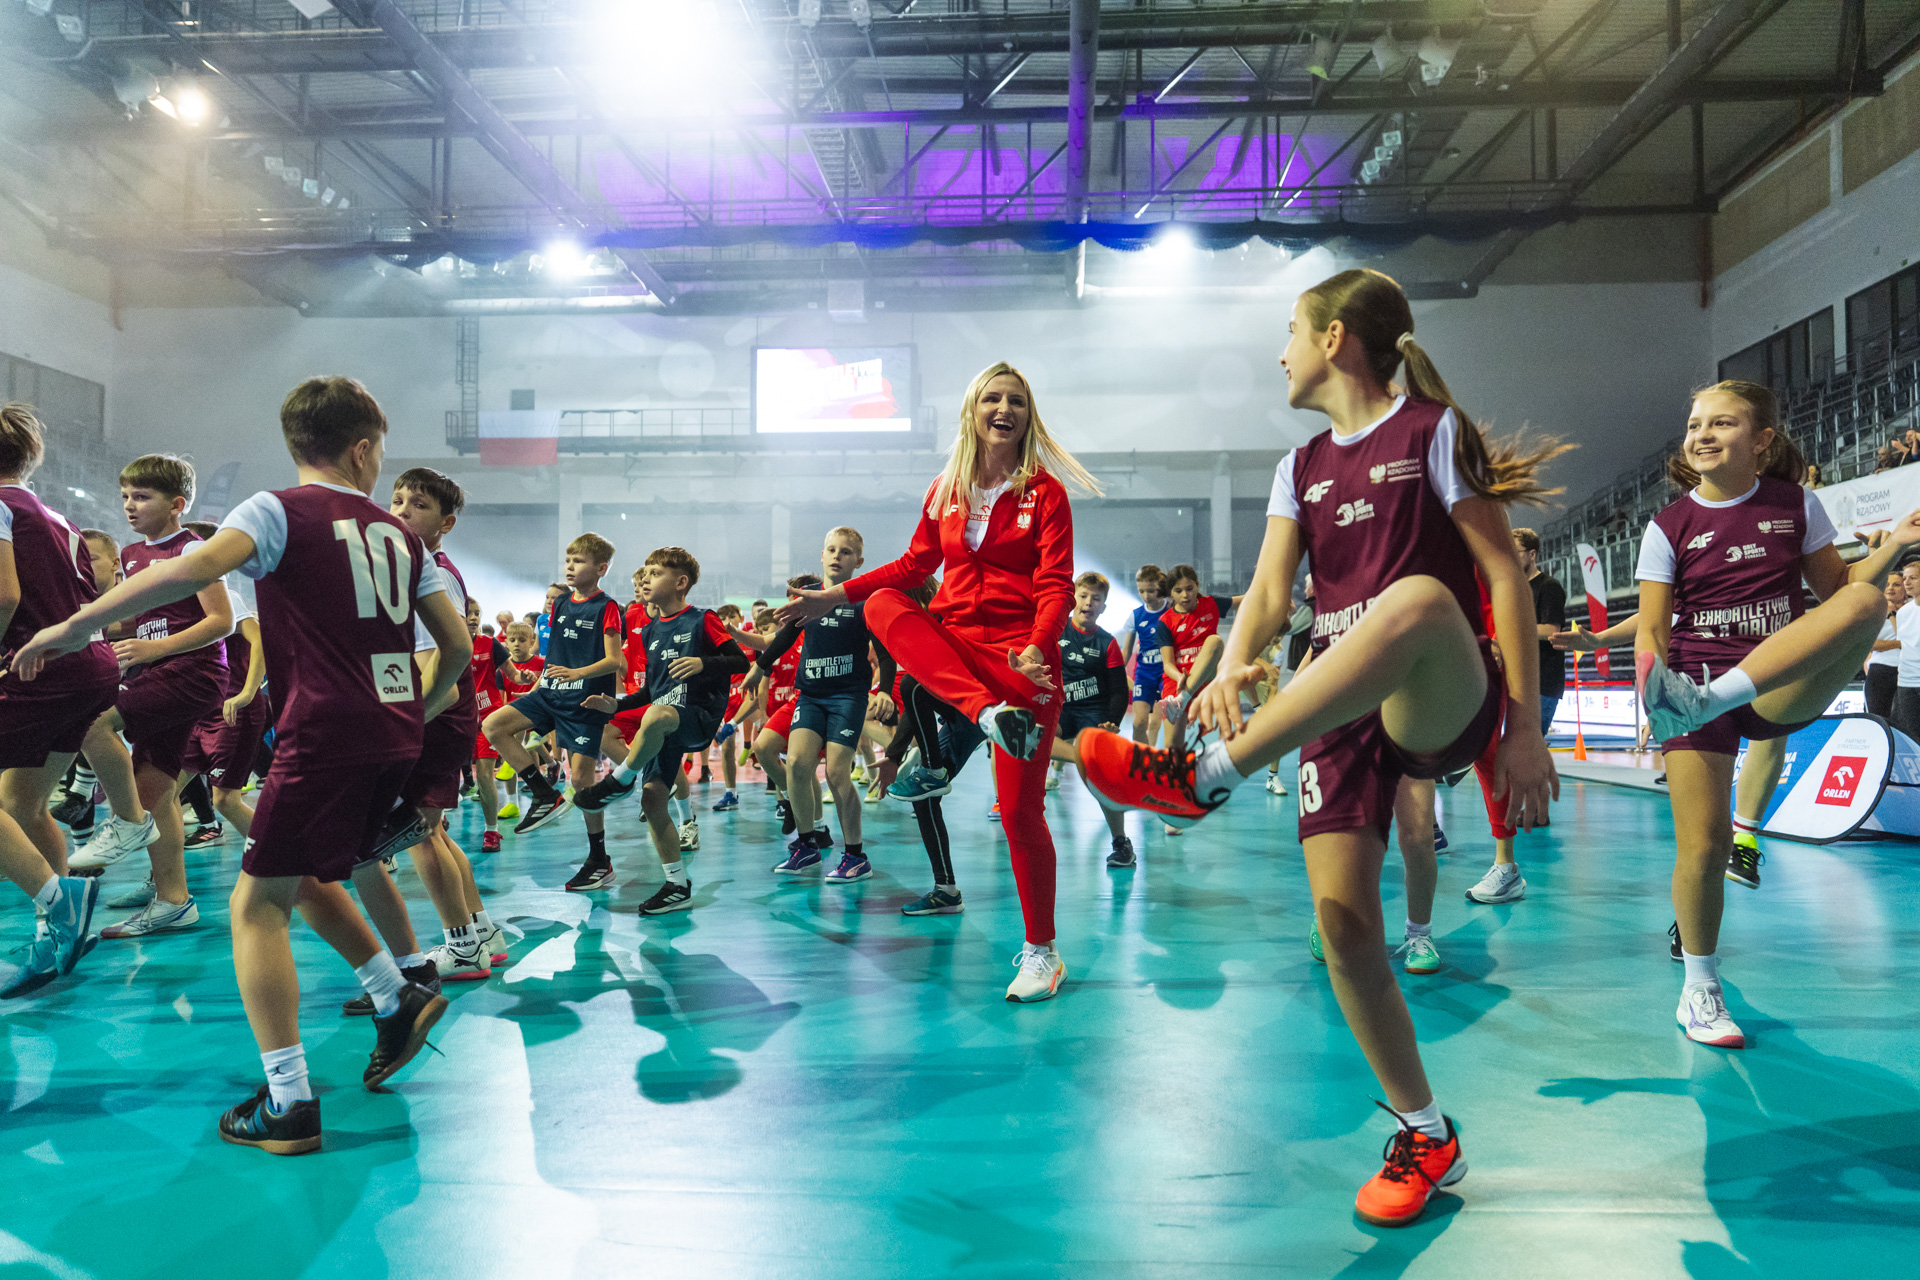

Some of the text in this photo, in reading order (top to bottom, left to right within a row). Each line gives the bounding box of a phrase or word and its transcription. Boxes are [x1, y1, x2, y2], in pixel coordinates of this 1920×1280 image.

[1387, 458, 1419, 468] PROGRAM
[1303, 479, 1334, 503] 4F
[1857, 489, 1890, 504] PROGRAM
[944, 504, 960, 517] F
[1856, 502, 1891, 516] RZĄDOWY
[1687, 530, 1715, 550] 4F
[332, 517, 412, 625] 10
[824, 662, 853, 678] ORLIKA
[382, 685, 409, 694] ORLEN
[1073, 684, 1100, 701] ORLIKA
[1031, 692, 1053, 706] 4F
[1834, 701, 1851, 715] 4F
[1823, 788, 1851, 799] ORLEN
[243, 834, 256, 853] F
[448, 939, 476, 948] adidas
